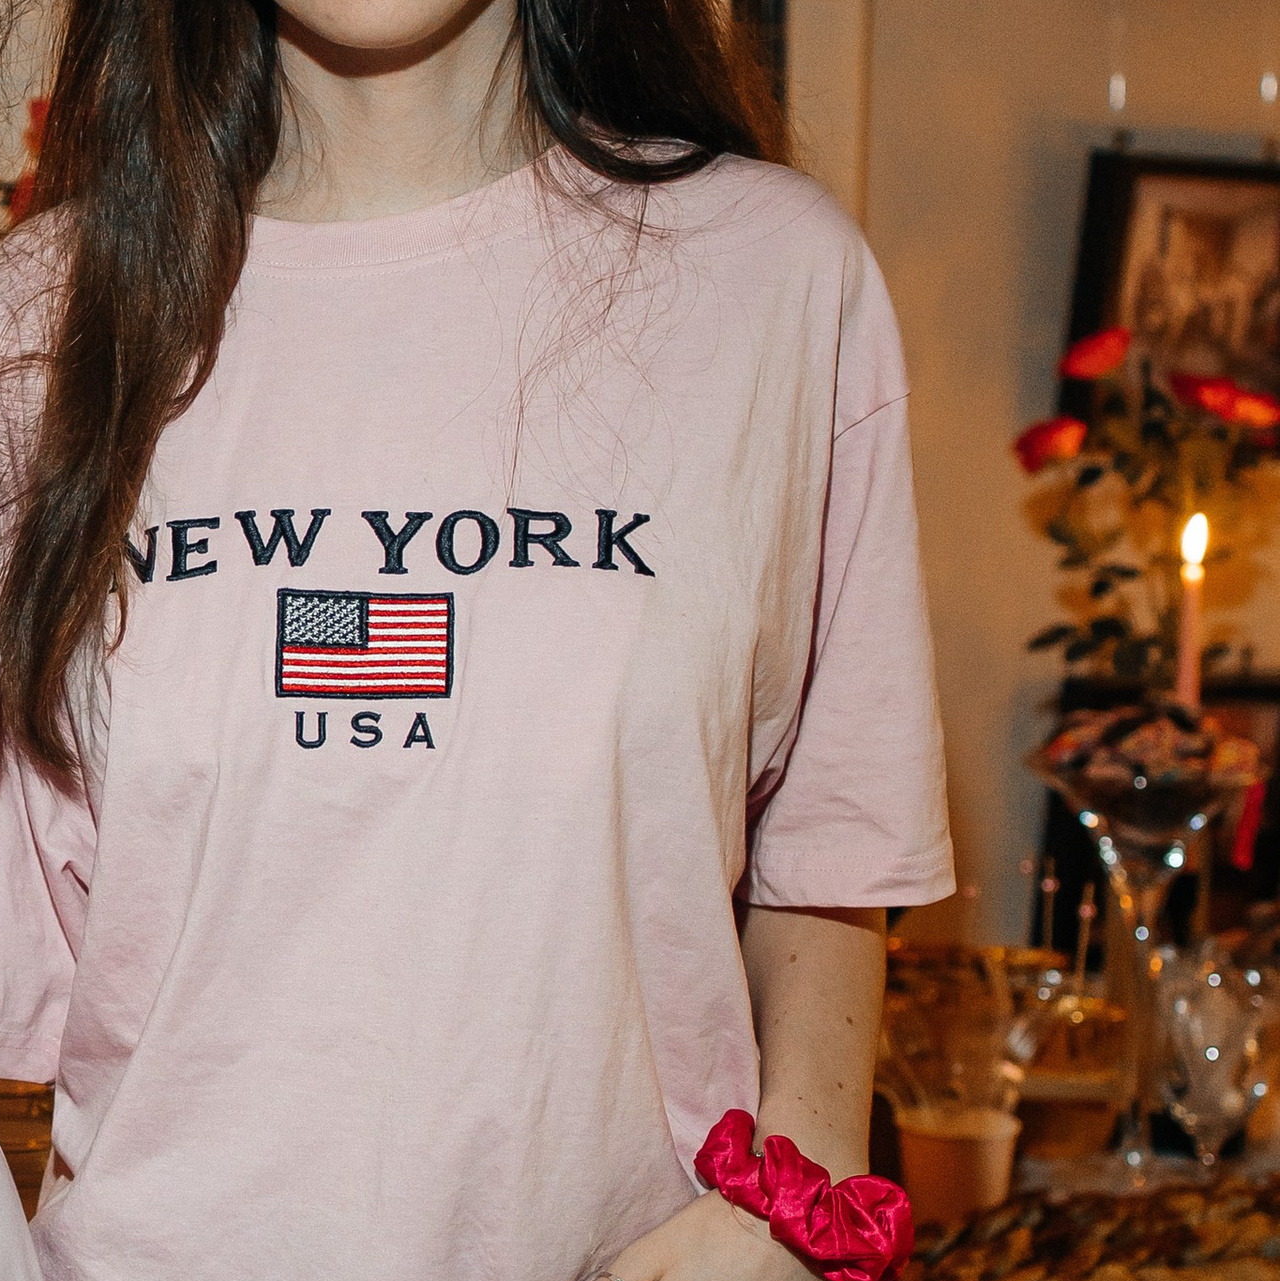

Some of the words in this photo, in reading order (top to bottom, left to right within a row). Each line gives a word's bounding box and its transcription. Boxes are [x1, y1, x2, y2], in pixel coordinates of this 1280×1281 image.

[122, 508, 332, 584] NEW
[361, 506, 656, 578] YORK
[294, 710, 437, 750] USA
